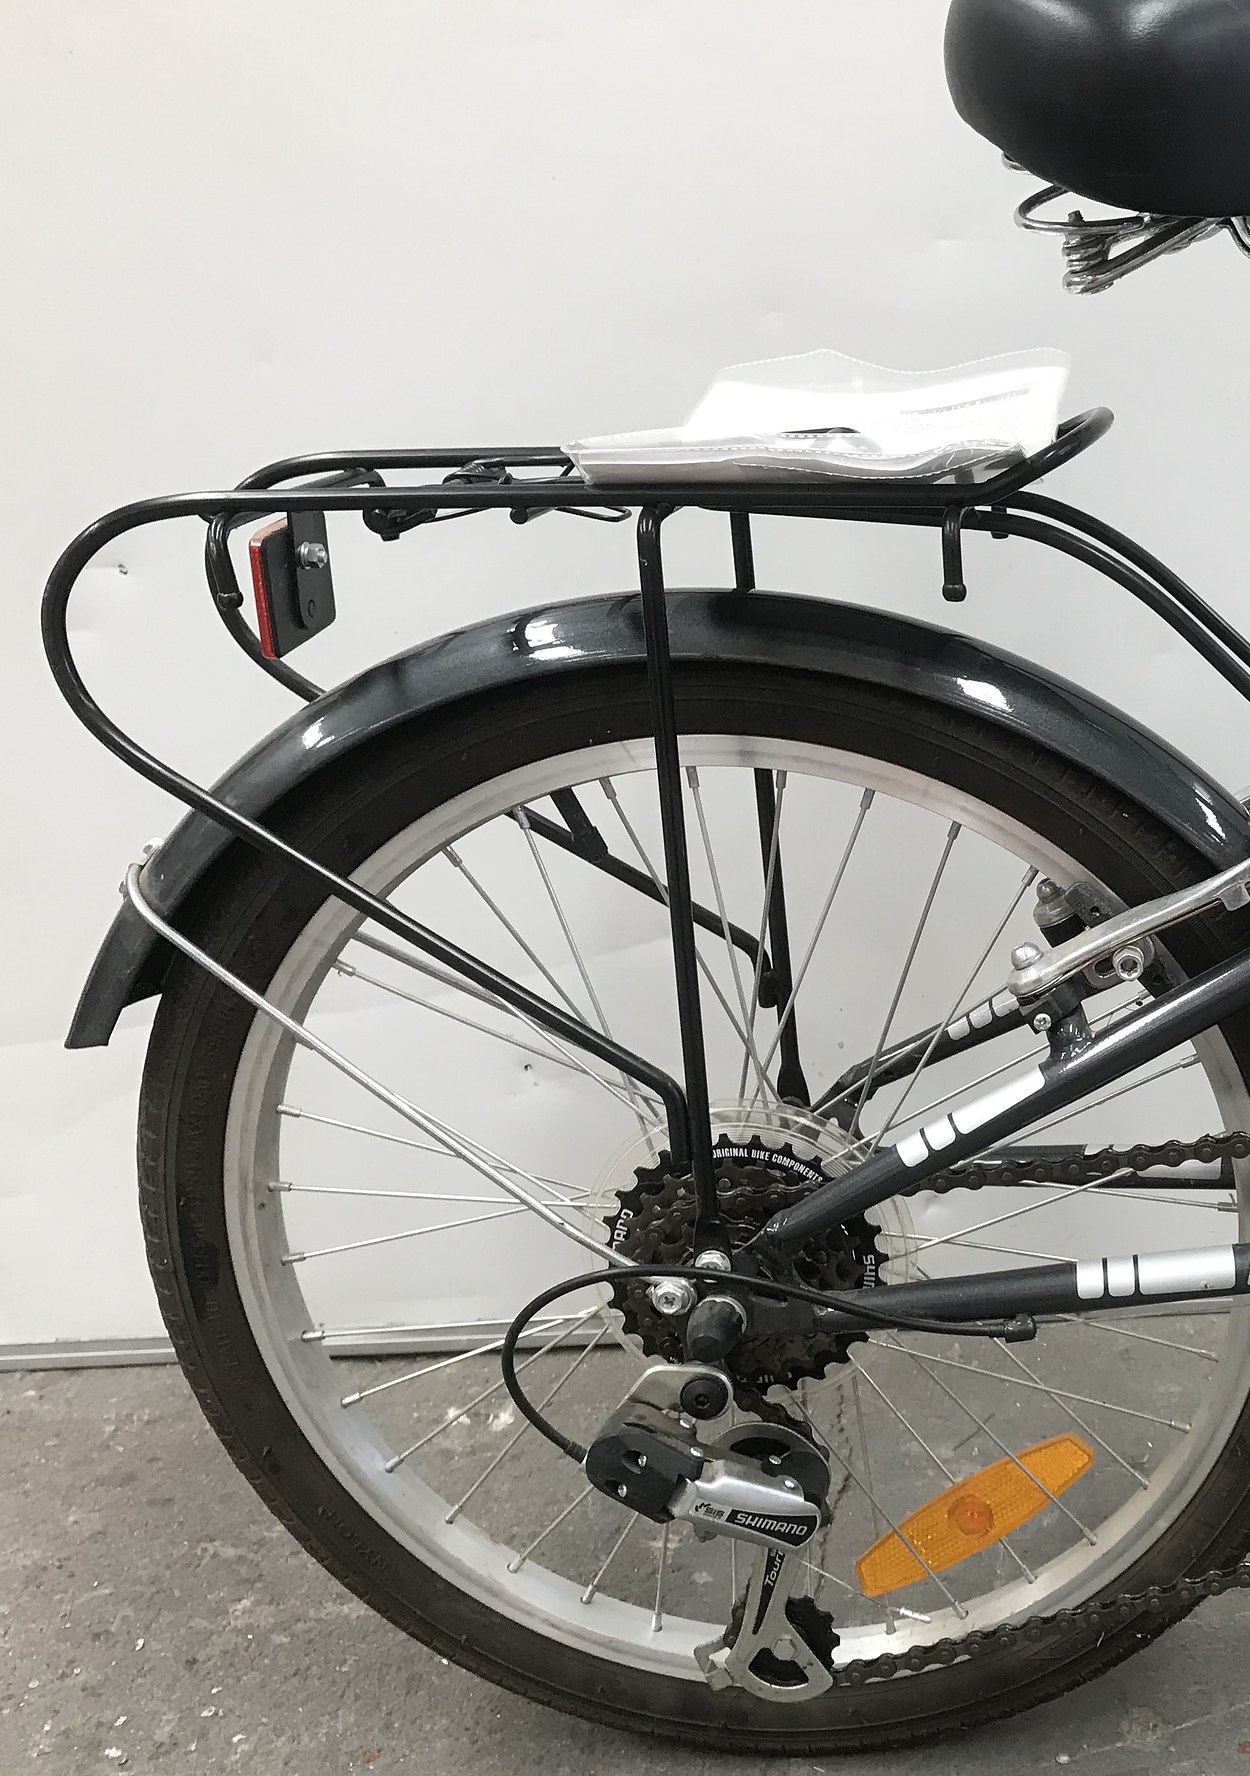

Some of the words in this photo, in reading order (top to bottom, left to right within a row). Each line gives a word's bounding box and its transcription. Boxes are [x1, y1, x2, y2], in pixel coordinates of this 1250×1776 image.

[751, 1149, 771, 1161] BIKE
[772, 1153, 823, 1182] COMPONENTS
[735, 1513, 808, 1536] SHIMANO
